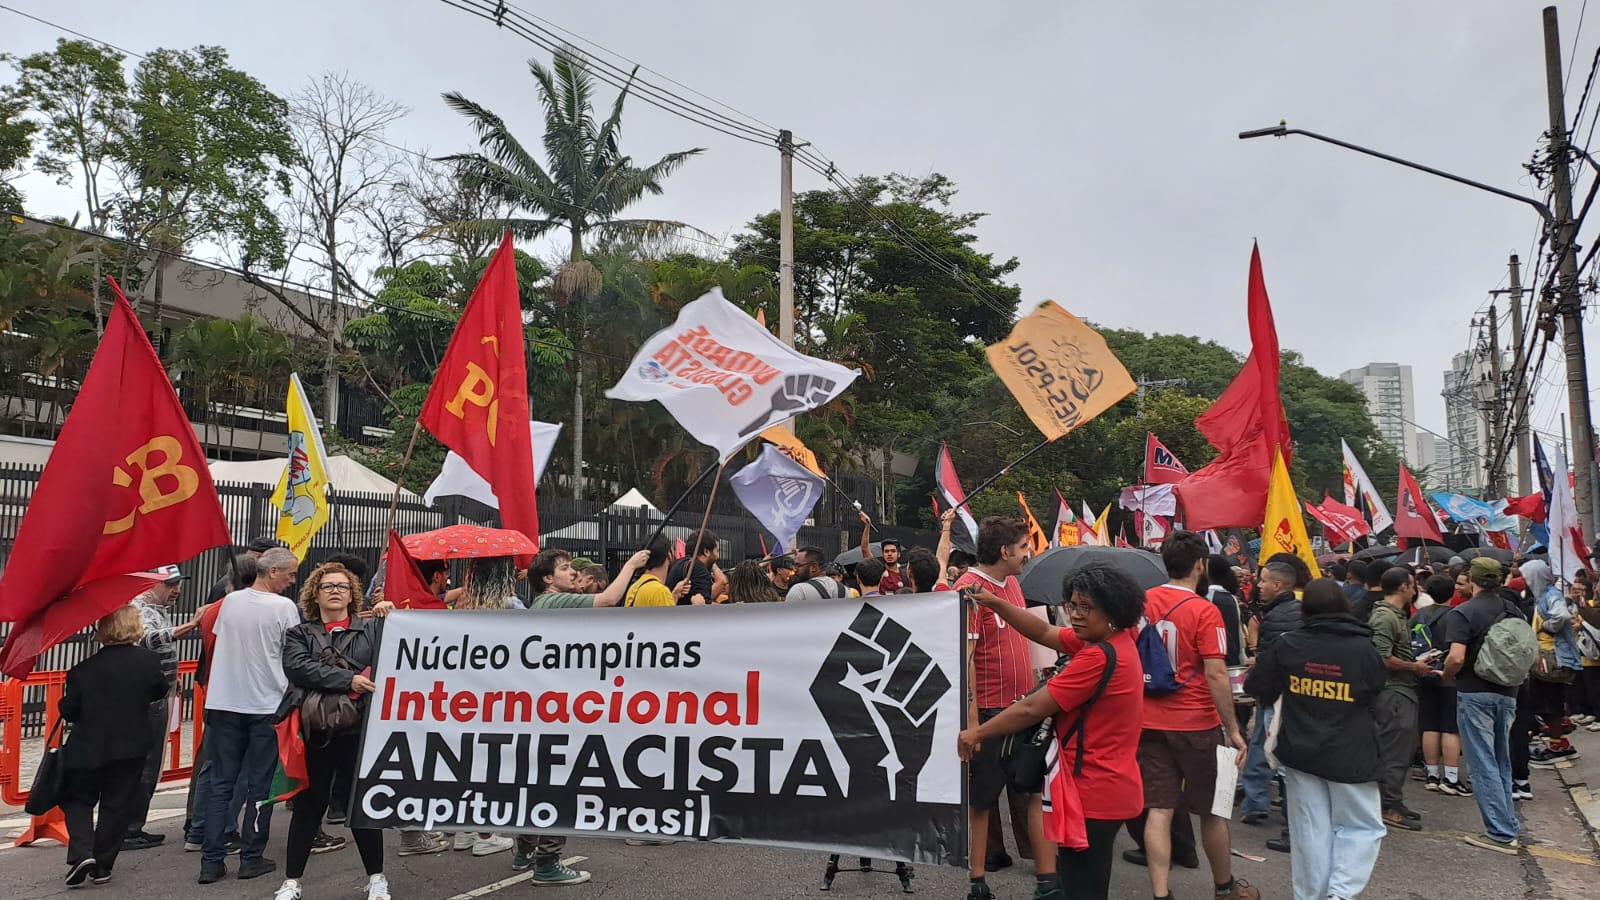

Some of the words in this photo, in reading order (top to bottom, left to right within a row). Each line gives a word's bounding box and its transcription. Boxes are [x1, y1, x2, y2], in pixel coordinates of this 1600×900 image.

[395, 634, 510, 671] Núcleo
[519, 632, 702, 680] Campinas
[380, 671, 760, 726] Internacional
[1289, 675, 1355, 703] BRASIL
[363, 731, 848, 798] ANTIFACISTA
[361, 784, 557, 832] Capítulo
[575, 794, 711, 838] Brasil
